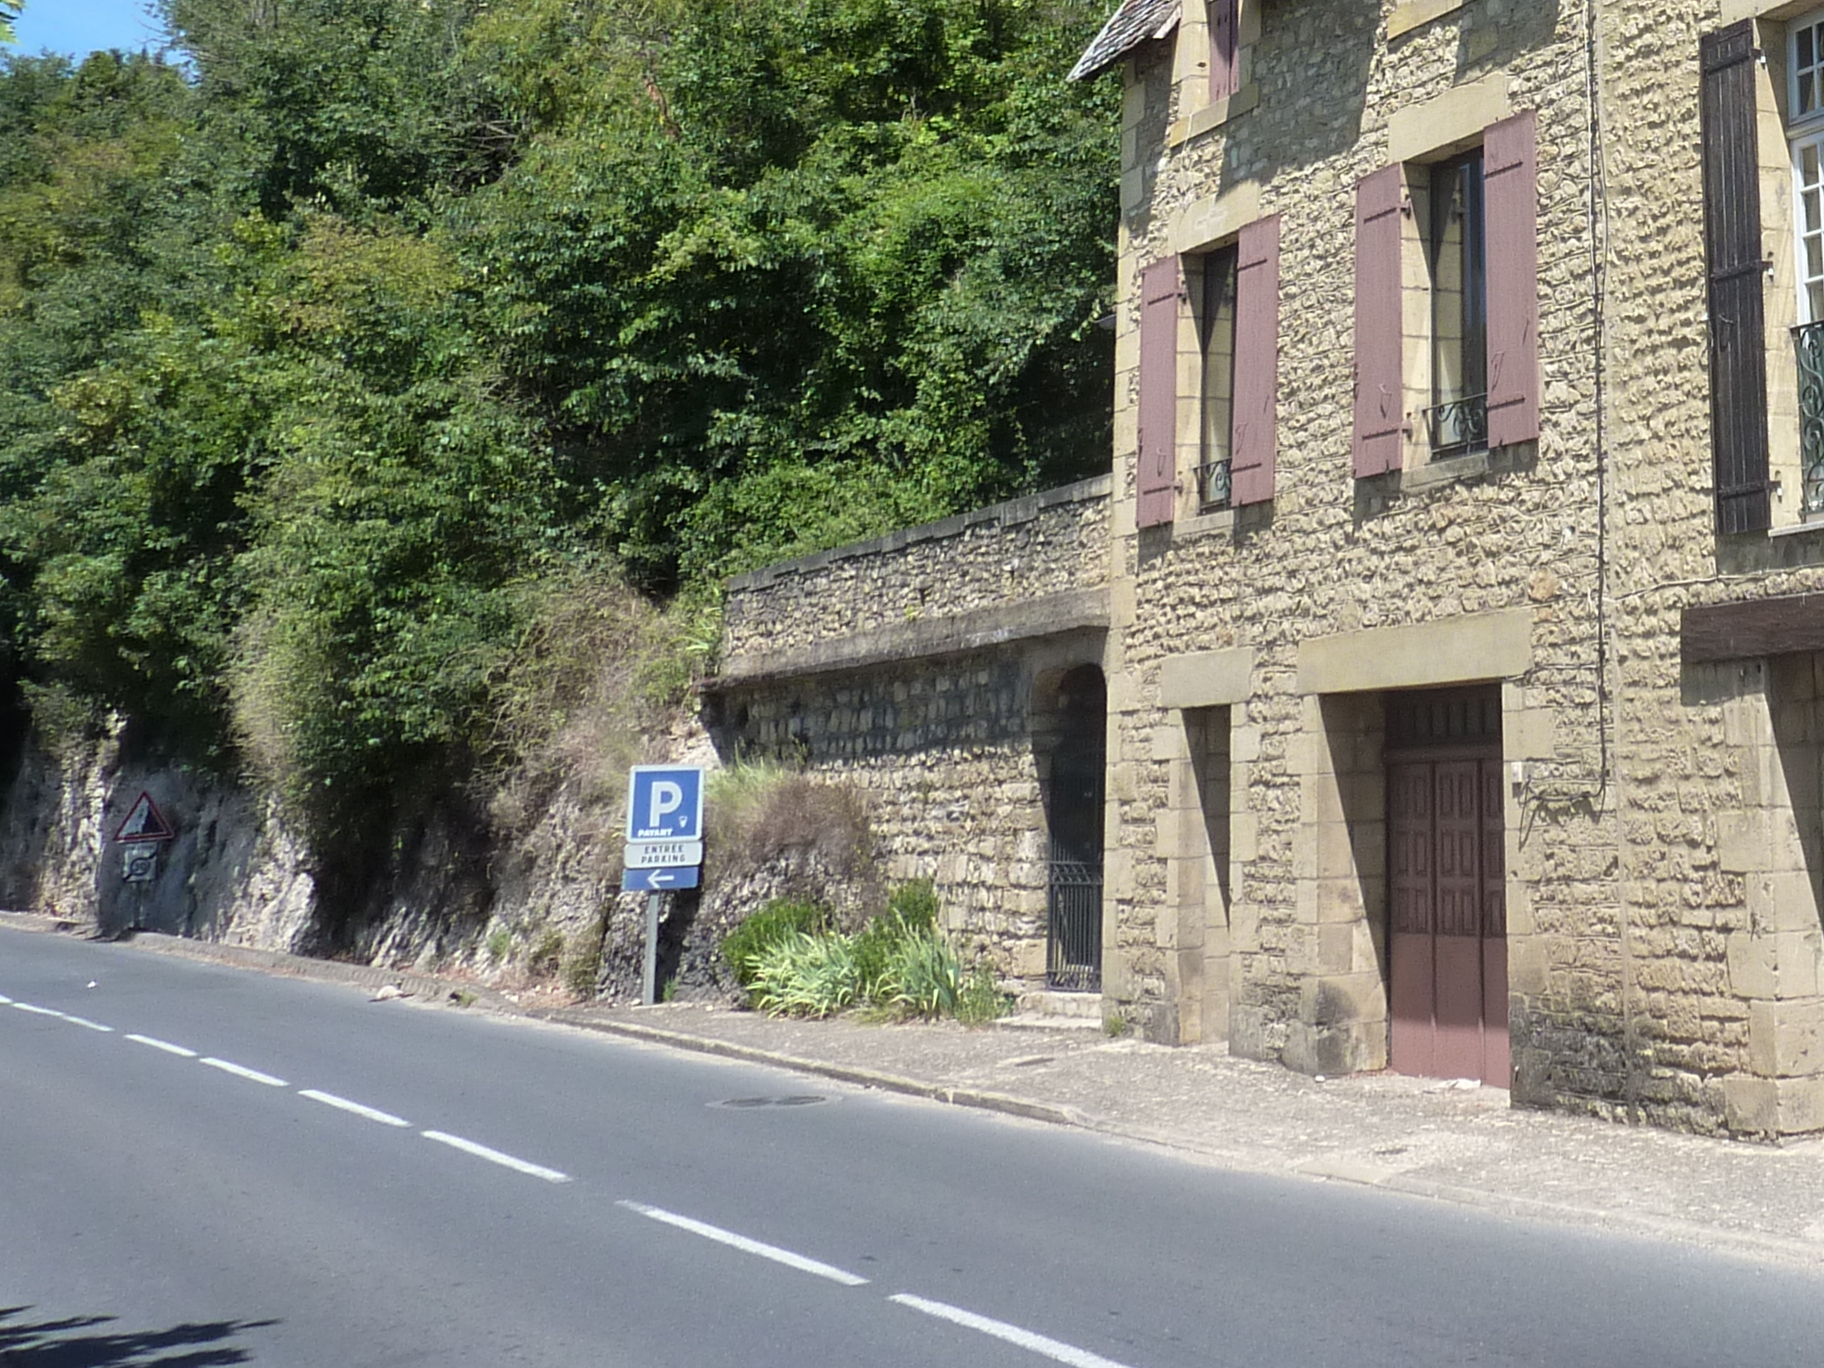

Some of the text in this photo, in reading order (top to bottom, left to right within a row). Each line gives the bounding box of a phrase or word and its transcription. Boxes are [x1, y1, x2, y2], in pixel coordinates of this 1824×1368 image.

[649, 781, 682, 827] P
[637, 828, 673, 837] PAYANT
[641, 854, 686, 864] PARKING
